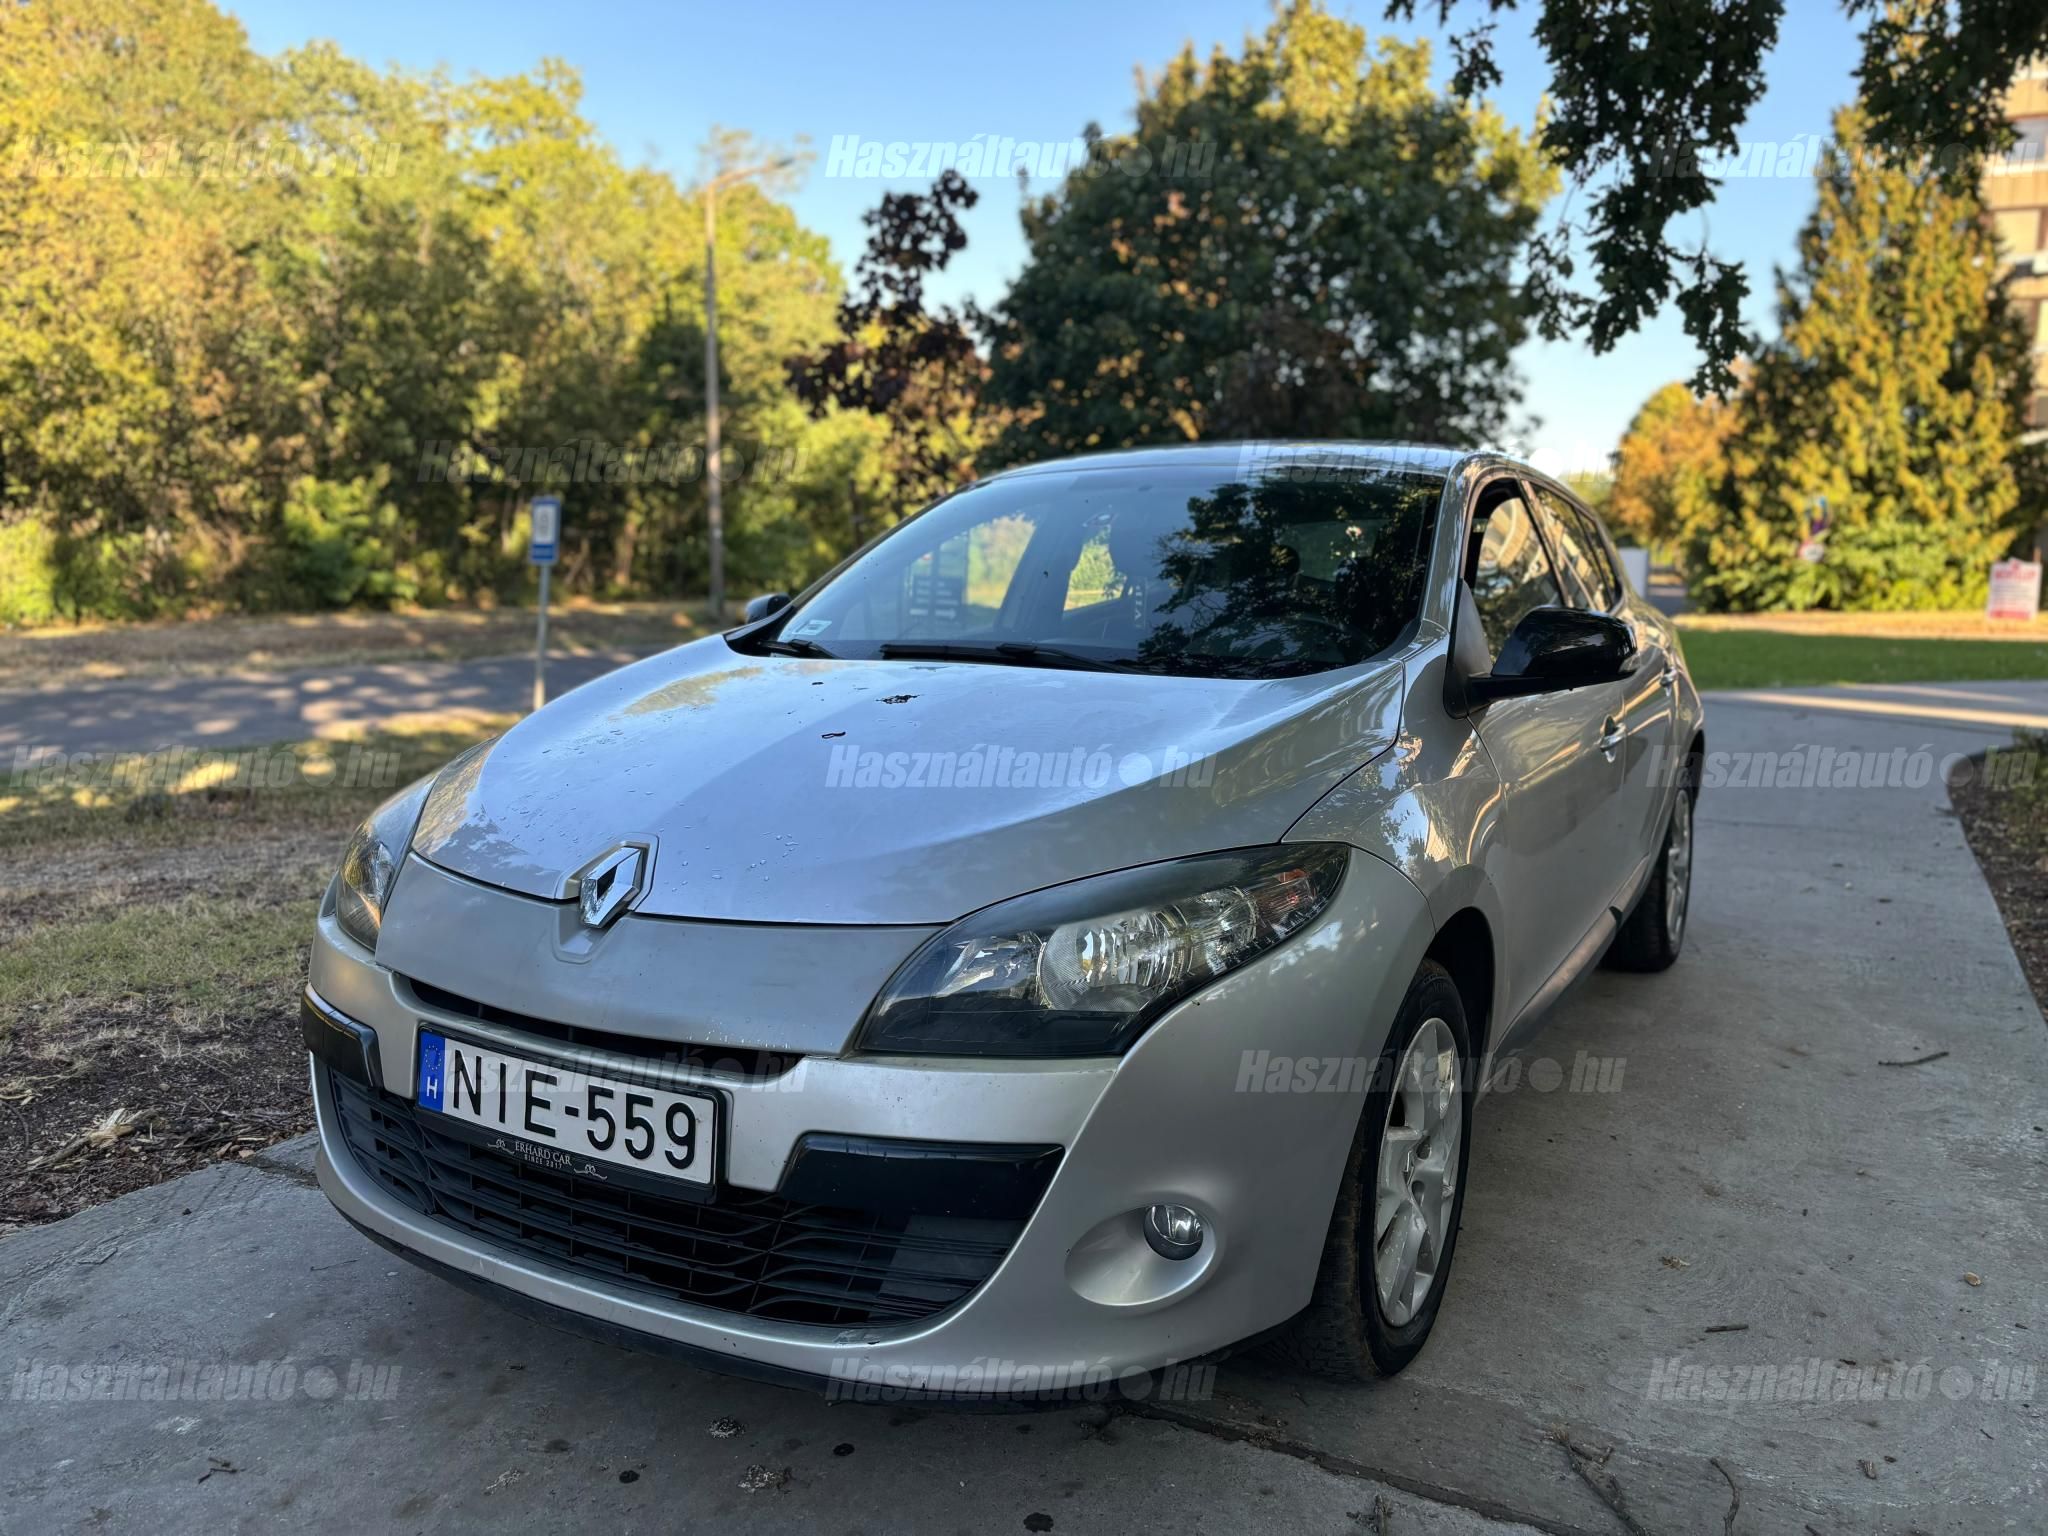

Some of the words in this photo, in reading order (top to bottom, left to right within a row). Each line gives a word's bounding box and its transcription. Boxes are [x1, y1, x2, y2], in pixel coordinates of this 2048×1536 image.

[426, 1076, 438, 1099] H
[453, 1049, 697, 1170] NIE-559
[515, 1141, 551, 1160] ERHARD
[552, 1151, 572, 1166] CAR
[524, 1154, 544, 1165] SINCE
